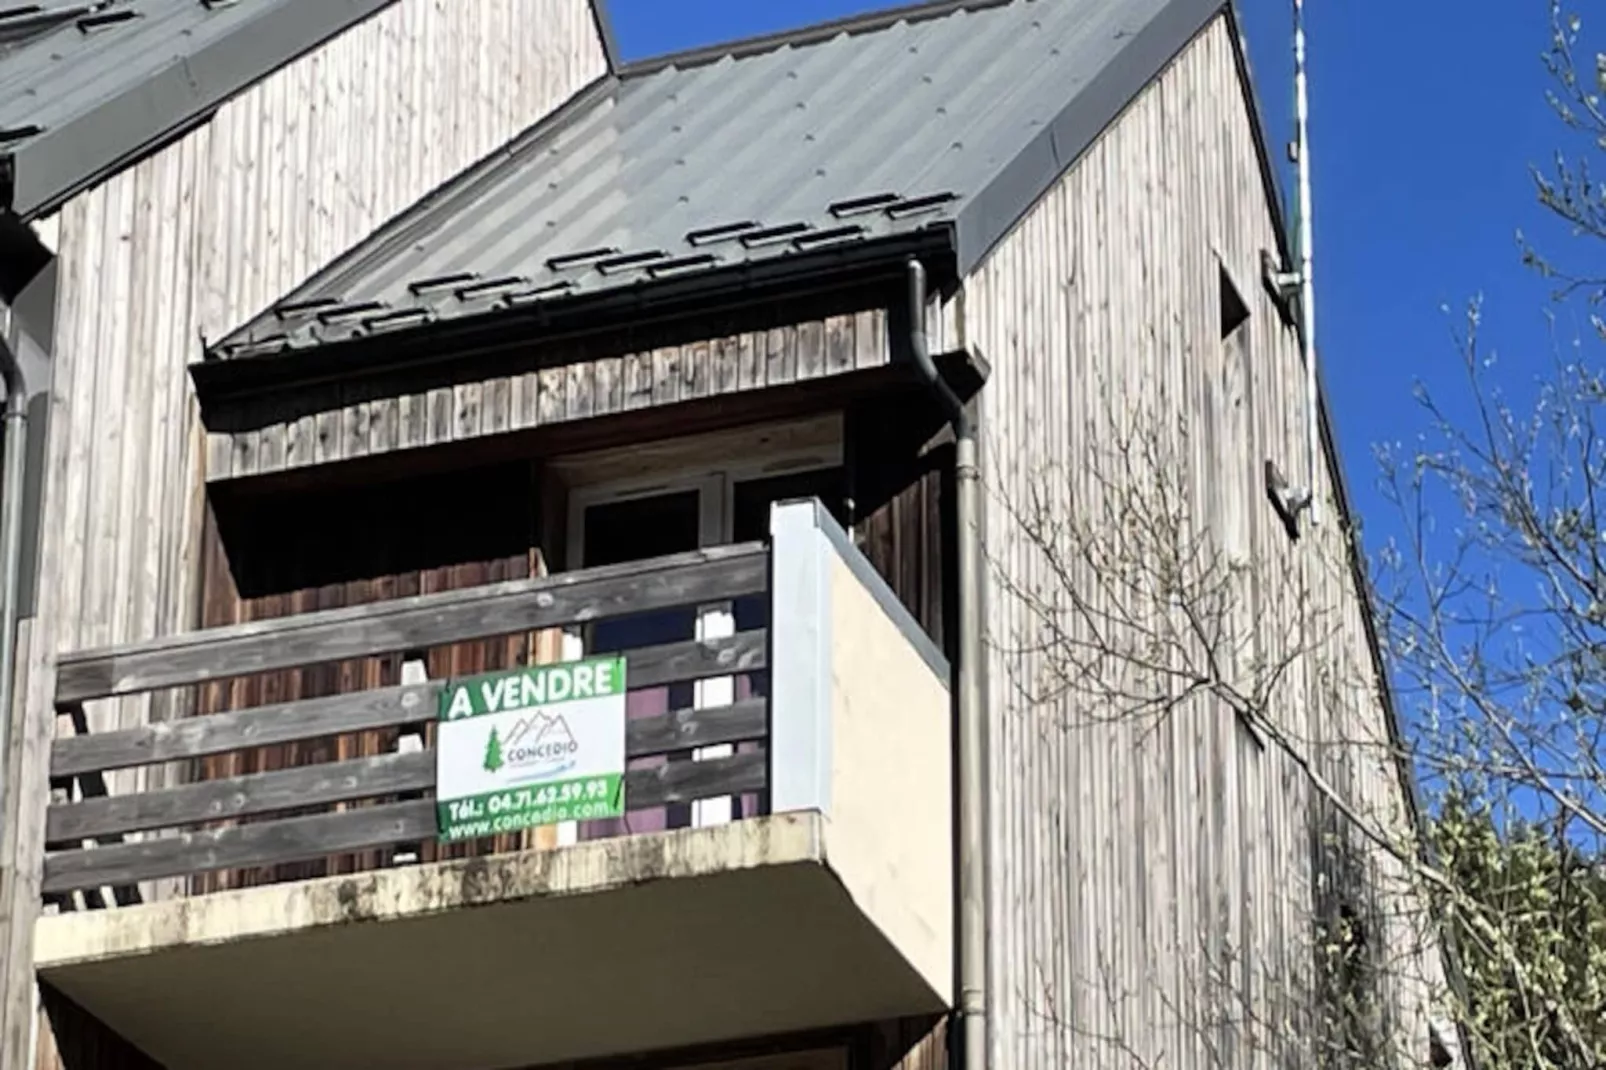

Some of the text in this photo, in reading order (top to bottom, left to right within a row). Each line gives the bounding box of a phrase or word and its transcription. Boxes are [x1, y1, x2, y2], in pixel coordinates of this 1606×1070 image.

[449, 663, 612, 718] A VENDRE
[507, 741, 579, 762] CONCEDIO
[449, 802, 608, 840] www.concedio.com
